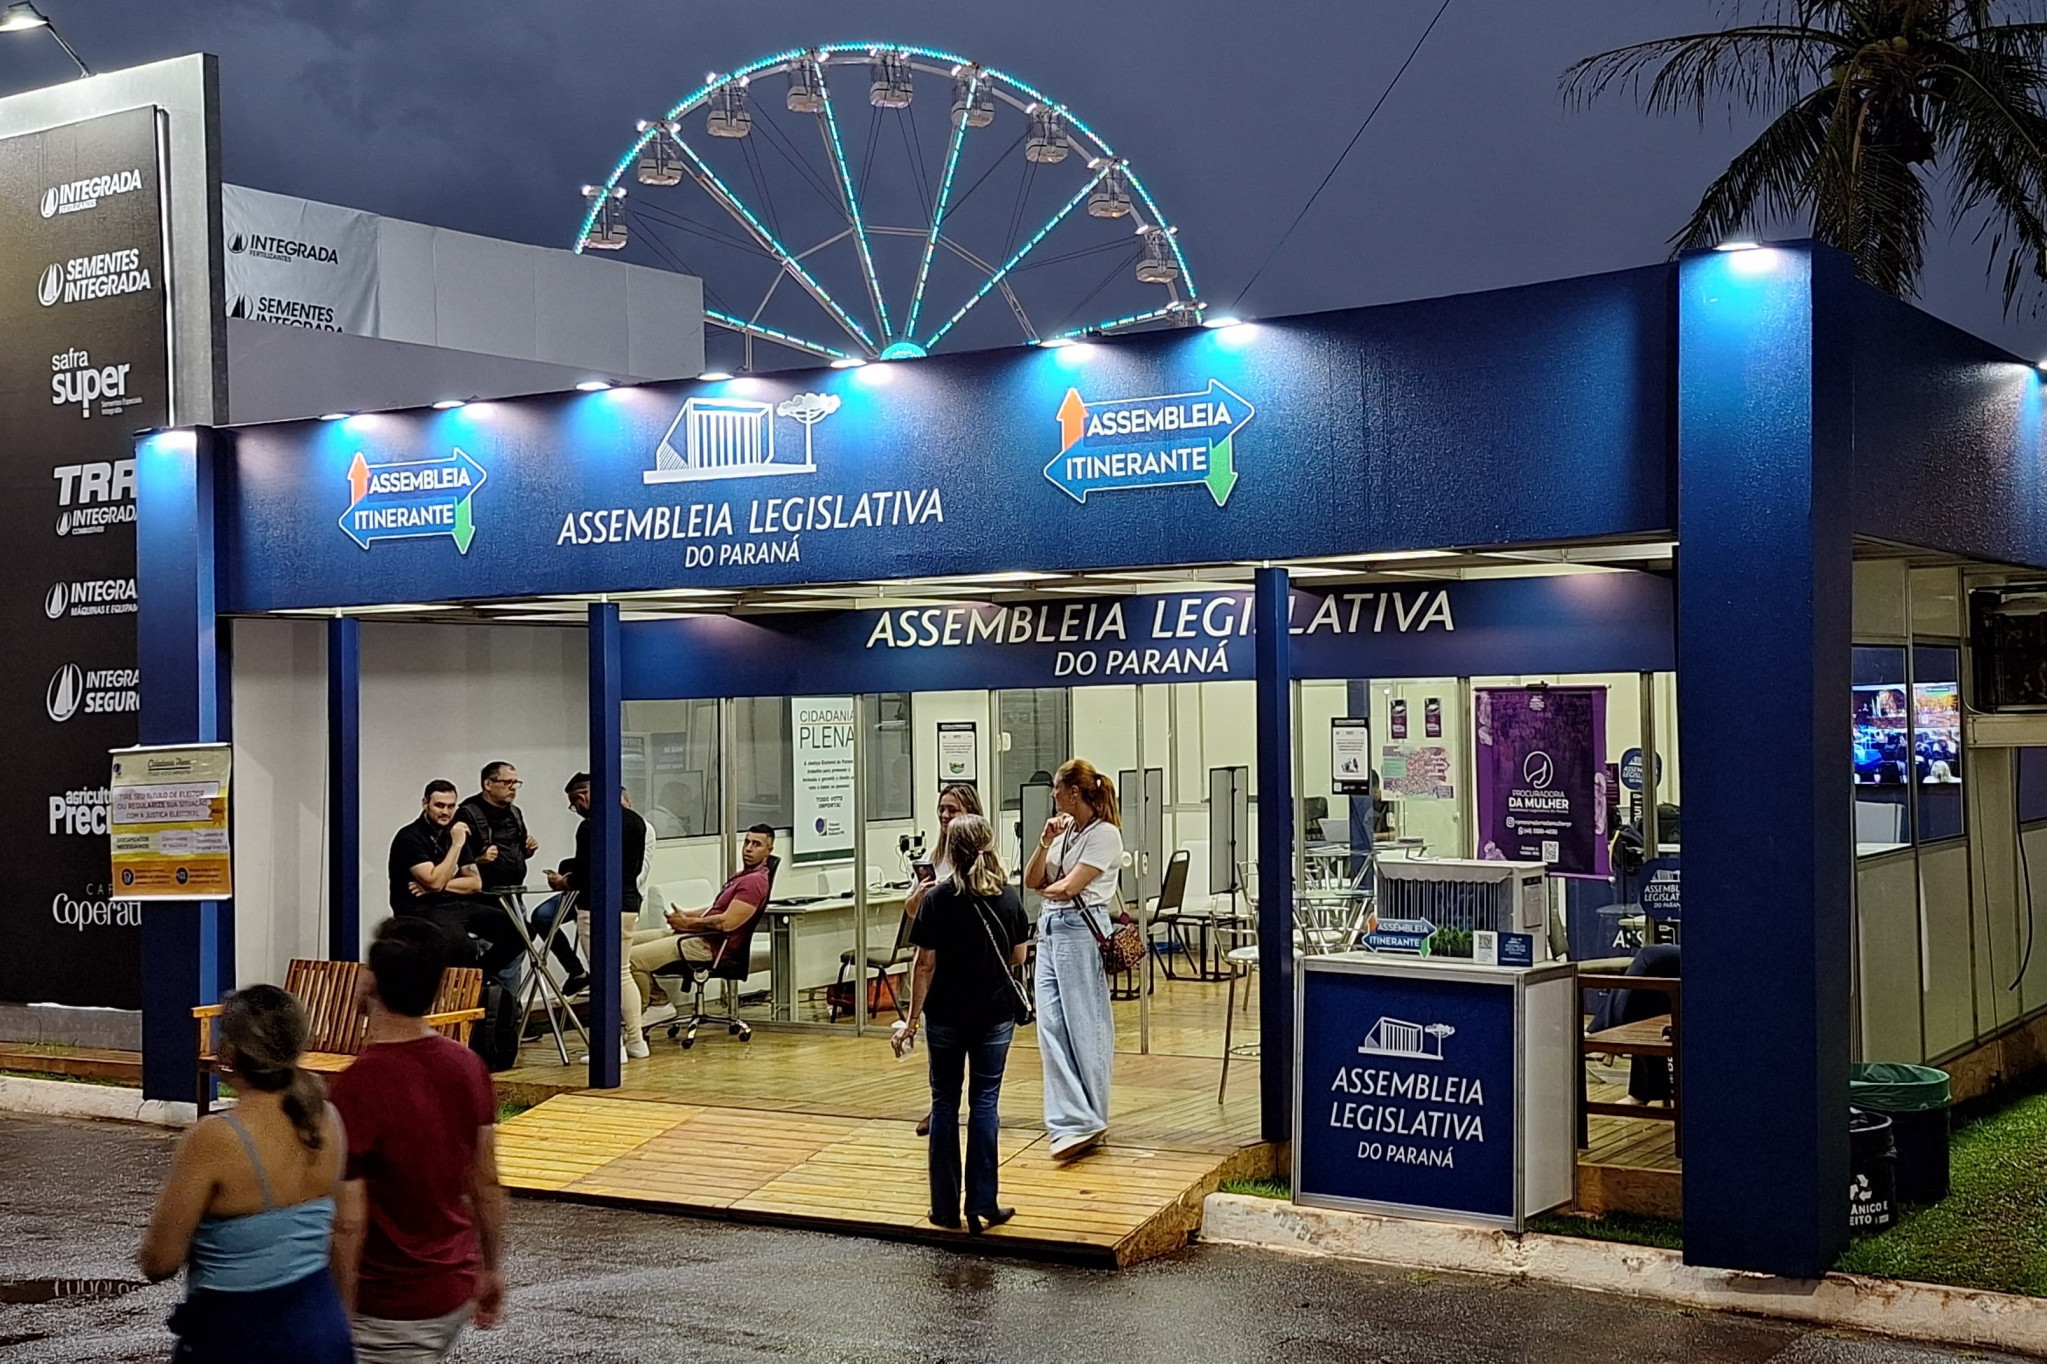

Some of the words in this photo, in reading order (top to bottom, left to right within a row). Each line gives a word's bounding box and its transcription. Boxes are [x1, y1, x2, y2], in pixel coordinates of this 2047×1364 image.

[60, 169, 142, 205] INTEGRADA
[249, 250, 292, 263] FERTILIZANTES
[250, 234, 338, 264] INTEGRADA
[66, 248, 139, 281] SEMENTES
[64, 268, 151, 303] INTEGRADA
[258, 296, 334, 323] SEMENTES
[51, 348, 89, 371] safra
[51, 362, 130, 418] super
[1086, 401, 1233, 437] ASSEMBLEIA
[1066, 446, 1207, 481] ITINERANTE
[369, 467, 472, 494] ASSEMBLEIA
[72, 505, 137, 527] INTEGRAD
[354, 503, 455, 530] ITINERANTE
[556, 502, 734, 546] ASSEMBLEIA
[748, 487, 944, 534] LEGISLATIVA
[684, 545, 714, 568] DO
[719, 535, 801, 566] PARANÁ
[866, 602, 1127, 648] ASSEMBLEIA
[1151, 590, 1455, 639] LEGILATIVA
[1054, 651, 1098, 676] DO
[1105, 639, 1229, 676] PARANÁ
[800, 726, 854, 749] PLENA
[1508, 797, 1523, 808] DA
[1525, 797, 1569, 809] MULHER
[1512, 789, 1565, 798] PROCURADORIA
[1369, 935, 1420, 947] ITINERANTE
[1377, 922, 1429, 934] ASSEMBLEIA
[1331, 1066, 1484, 1106] ASSEMBLEIA
[1330, 1101, 1484, 1142] LEGISLATIVA
[1357, 1141, 1382, 1160] DO
[1386, 1145, 1454, 1168] PARANÁ
